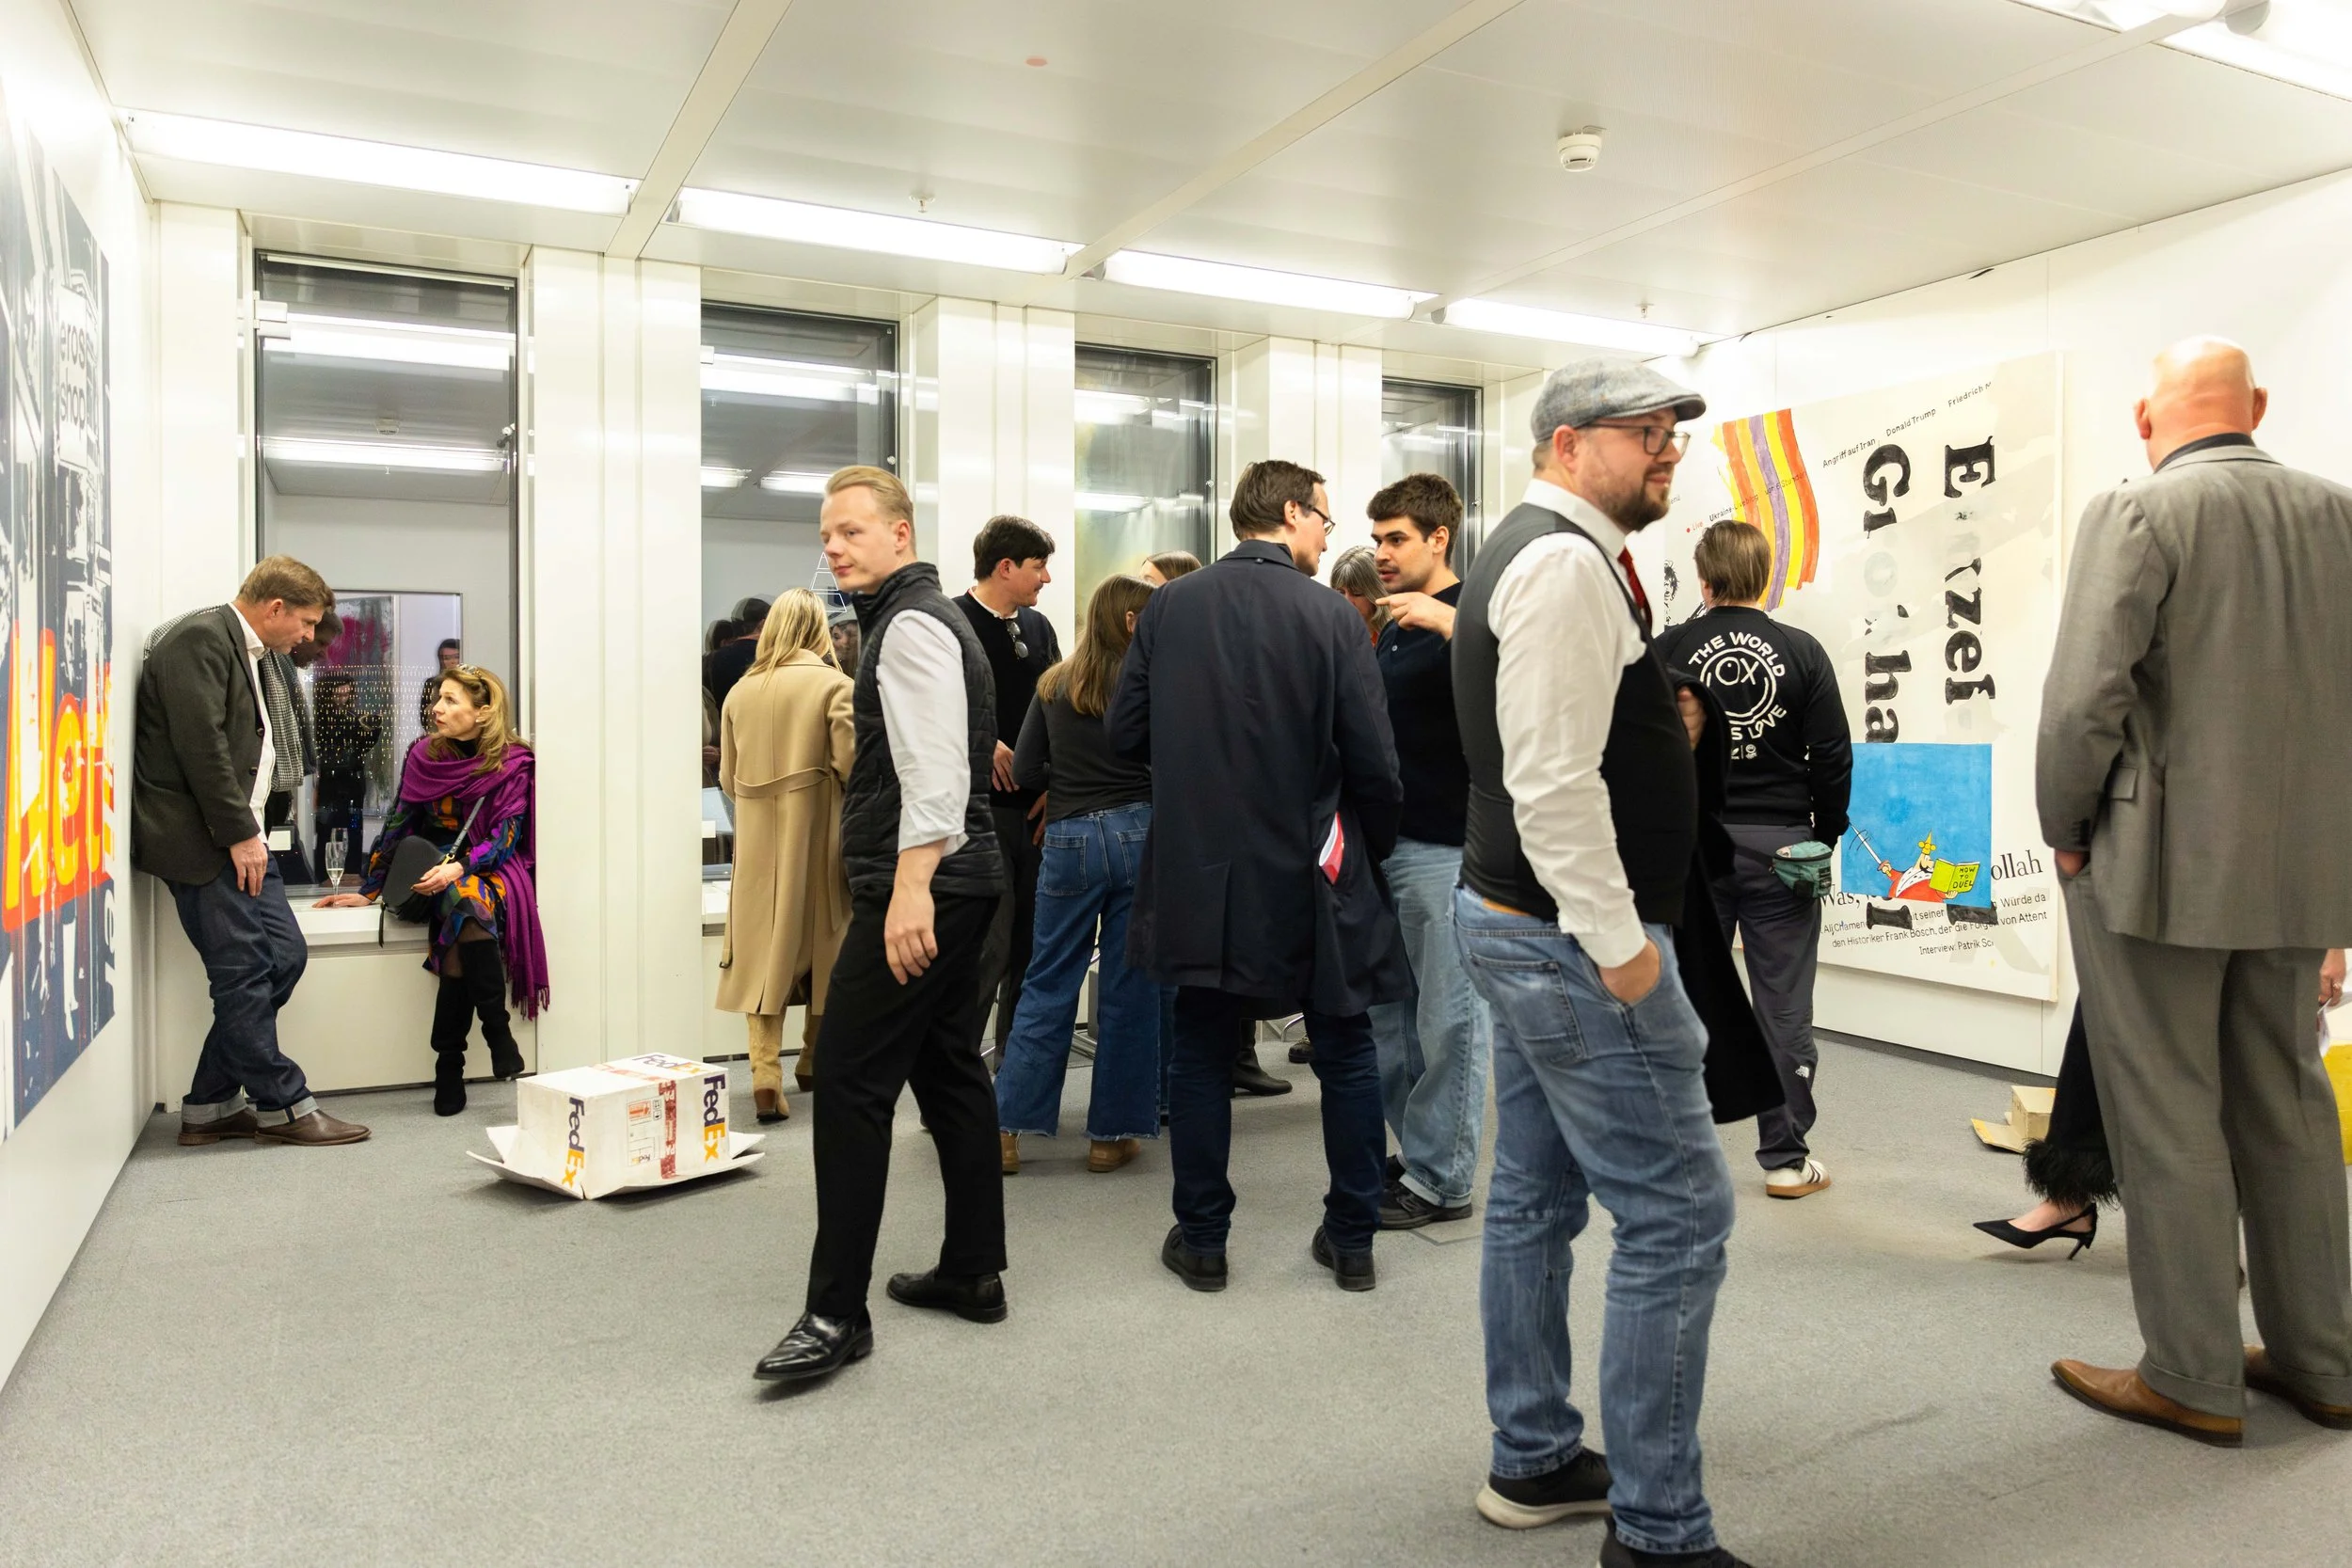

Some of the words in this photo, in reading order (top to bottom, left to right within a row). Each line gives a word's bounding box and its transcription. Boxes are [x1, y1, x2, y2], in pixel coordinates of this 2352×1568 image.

[60, 319, 86, 369] eros
[60, 370, 87, 443] shop
[1822, 448, 1847, 468] Angriff
[1847, 444, 1860, 457] auf
[1860, 436, 1876, 452] Iran
[1886, 418, 1911, 437] Donald
[1912, 406, 1937, 425] Trump
[1947, 385, 1983, 408] Friedrich
[1688, 635, 1726, 665] THE
[1729, 631, 1786, 677] WORLD
[1747, 704, 1788, 739] LOVE
[1952, 879, 1974, 889] DUEL
[1991, 849, 2043, 881] ollah
[1832, 939, 1846, 948] den
[1847, 932, 1884, 946] Historiker
[1885, 928, 1909, 942] Frank
[1938, 925, 1953, 935] der
[1955, 922, 1968, 932] die
[1999, 916, 2017, 926] von
[1919, 909, 1945, 921] seiner
[1958, 939, 1980, 951] Patrik
[703, 1073, 726, 1163] FedEx
[561, 1097, 585, 1189] FedEx
